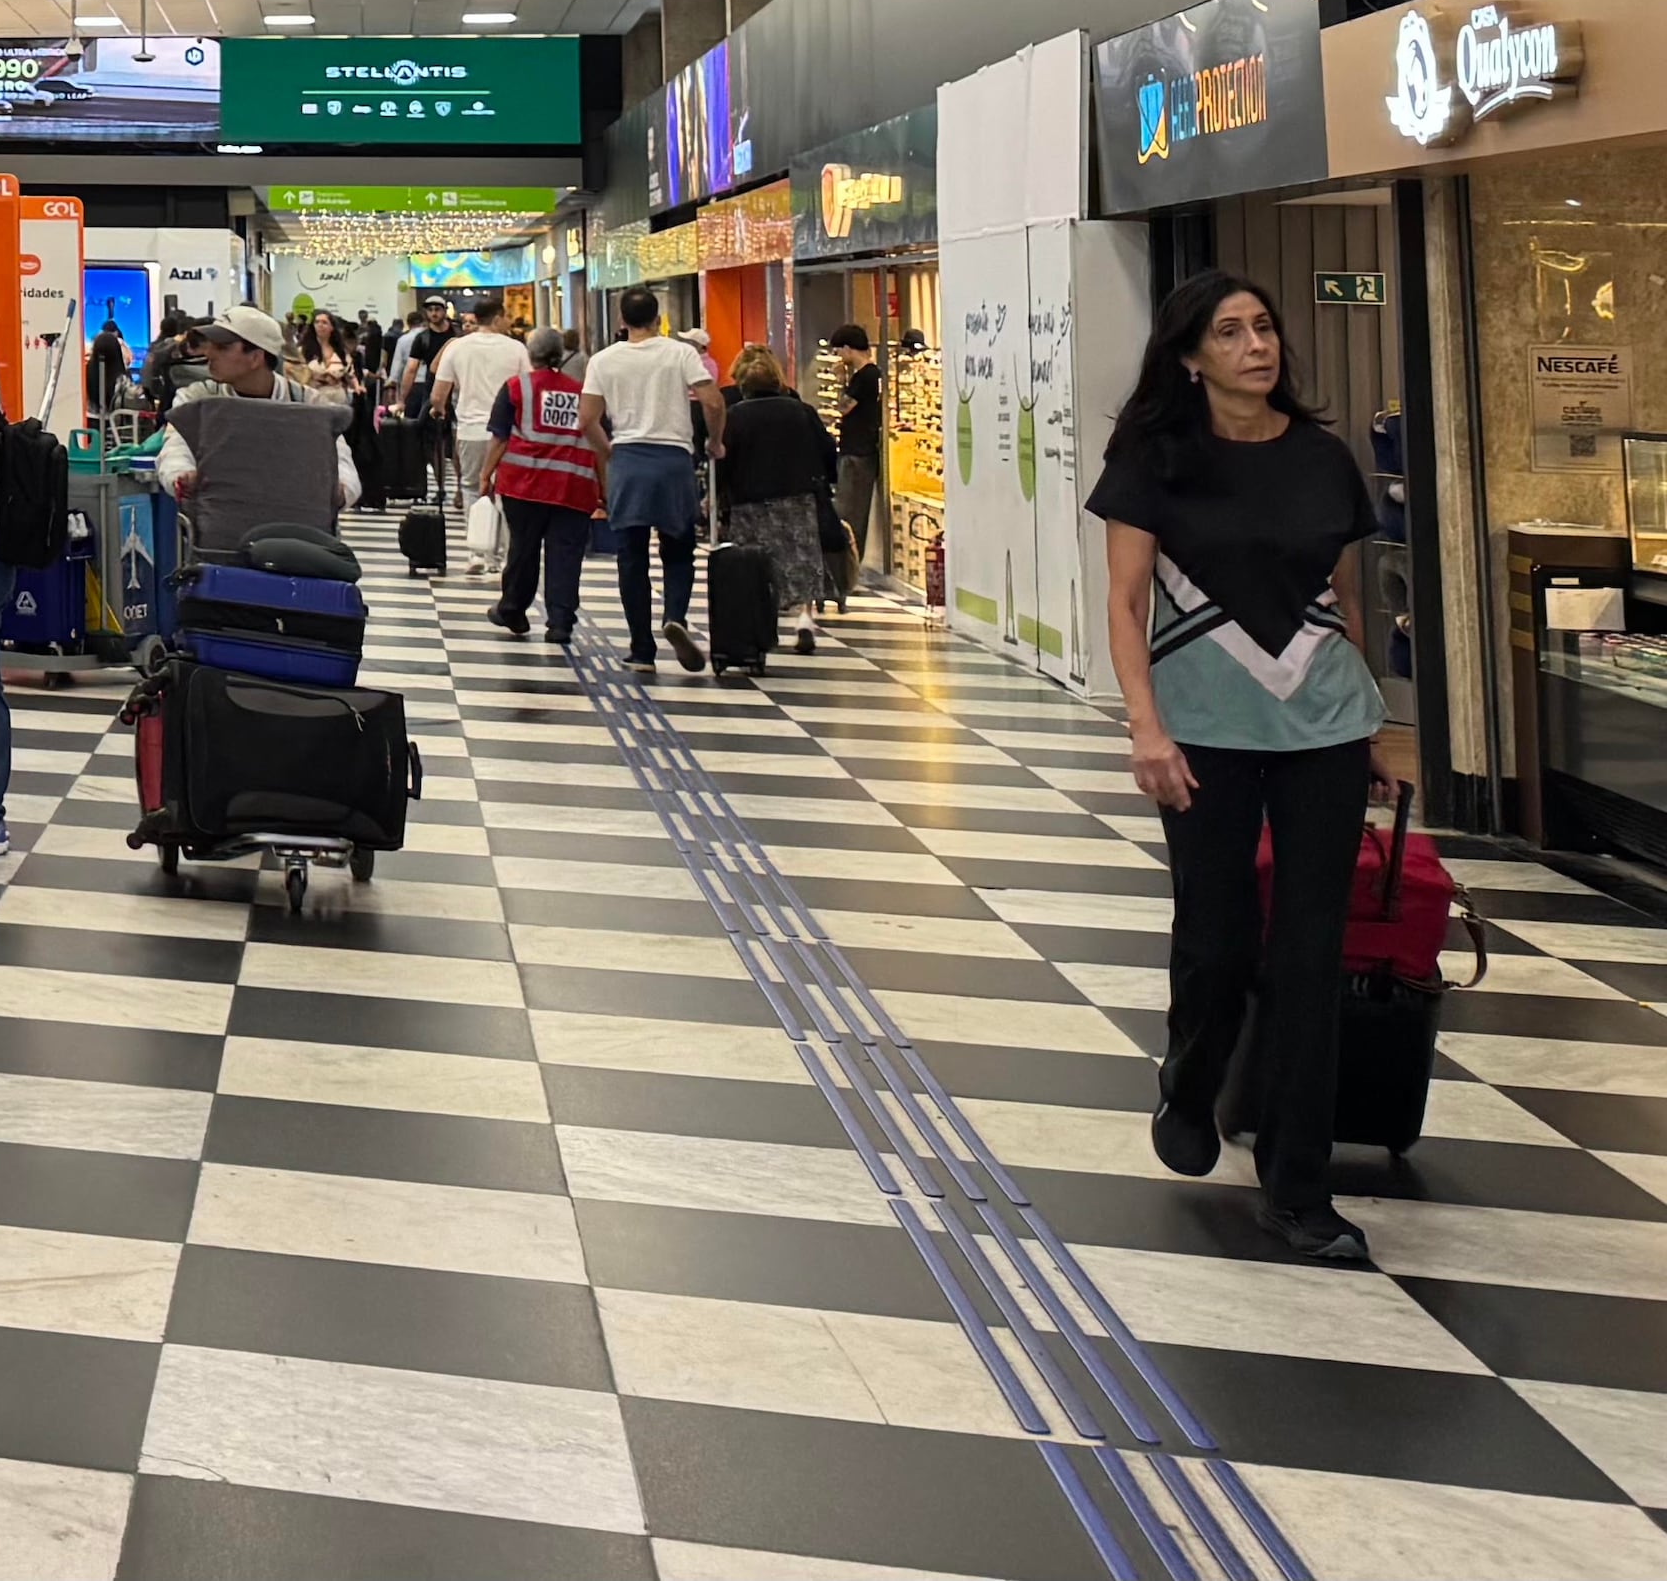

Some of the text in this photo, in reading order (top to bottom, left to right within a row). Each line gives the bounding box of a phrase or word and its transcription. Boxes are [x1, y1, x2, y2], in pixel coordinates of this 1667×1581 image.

[1455, 16, 1558, 106] Qualycon
[325, 62, 468, 82] STELLANTIS
[43, 201, 79, 218] GOL
[169, 267, 202, 281] Azul
[1537, 354, 1622, 374] NESCAFÉ
[544, 392, 577, 409] SDX
[544, 408, 578, 426] 0007
